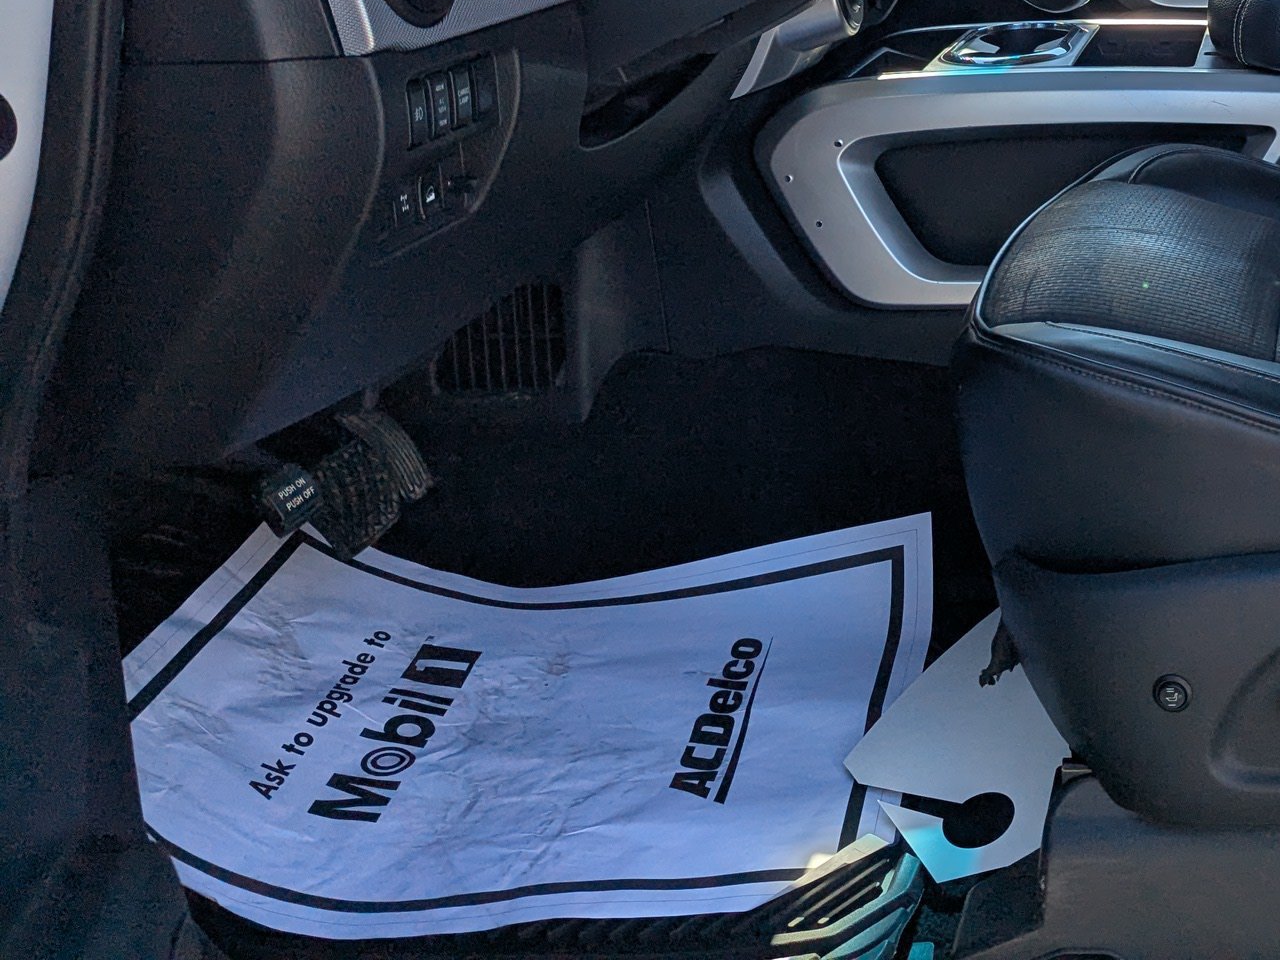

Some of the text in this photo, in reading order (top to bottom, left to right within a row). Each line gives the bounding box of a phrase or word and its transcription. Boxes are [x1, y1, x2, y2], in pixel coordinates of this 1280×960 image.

[278, 477, 306, 500] PUSH ON
[286, 486, 315, 511] PUSH OFF
[248, 630, 392, 800] Ask to upgrade to
[307, 687, 455, 823] Mobil
[668, 637, 763, 799] ACDelco
